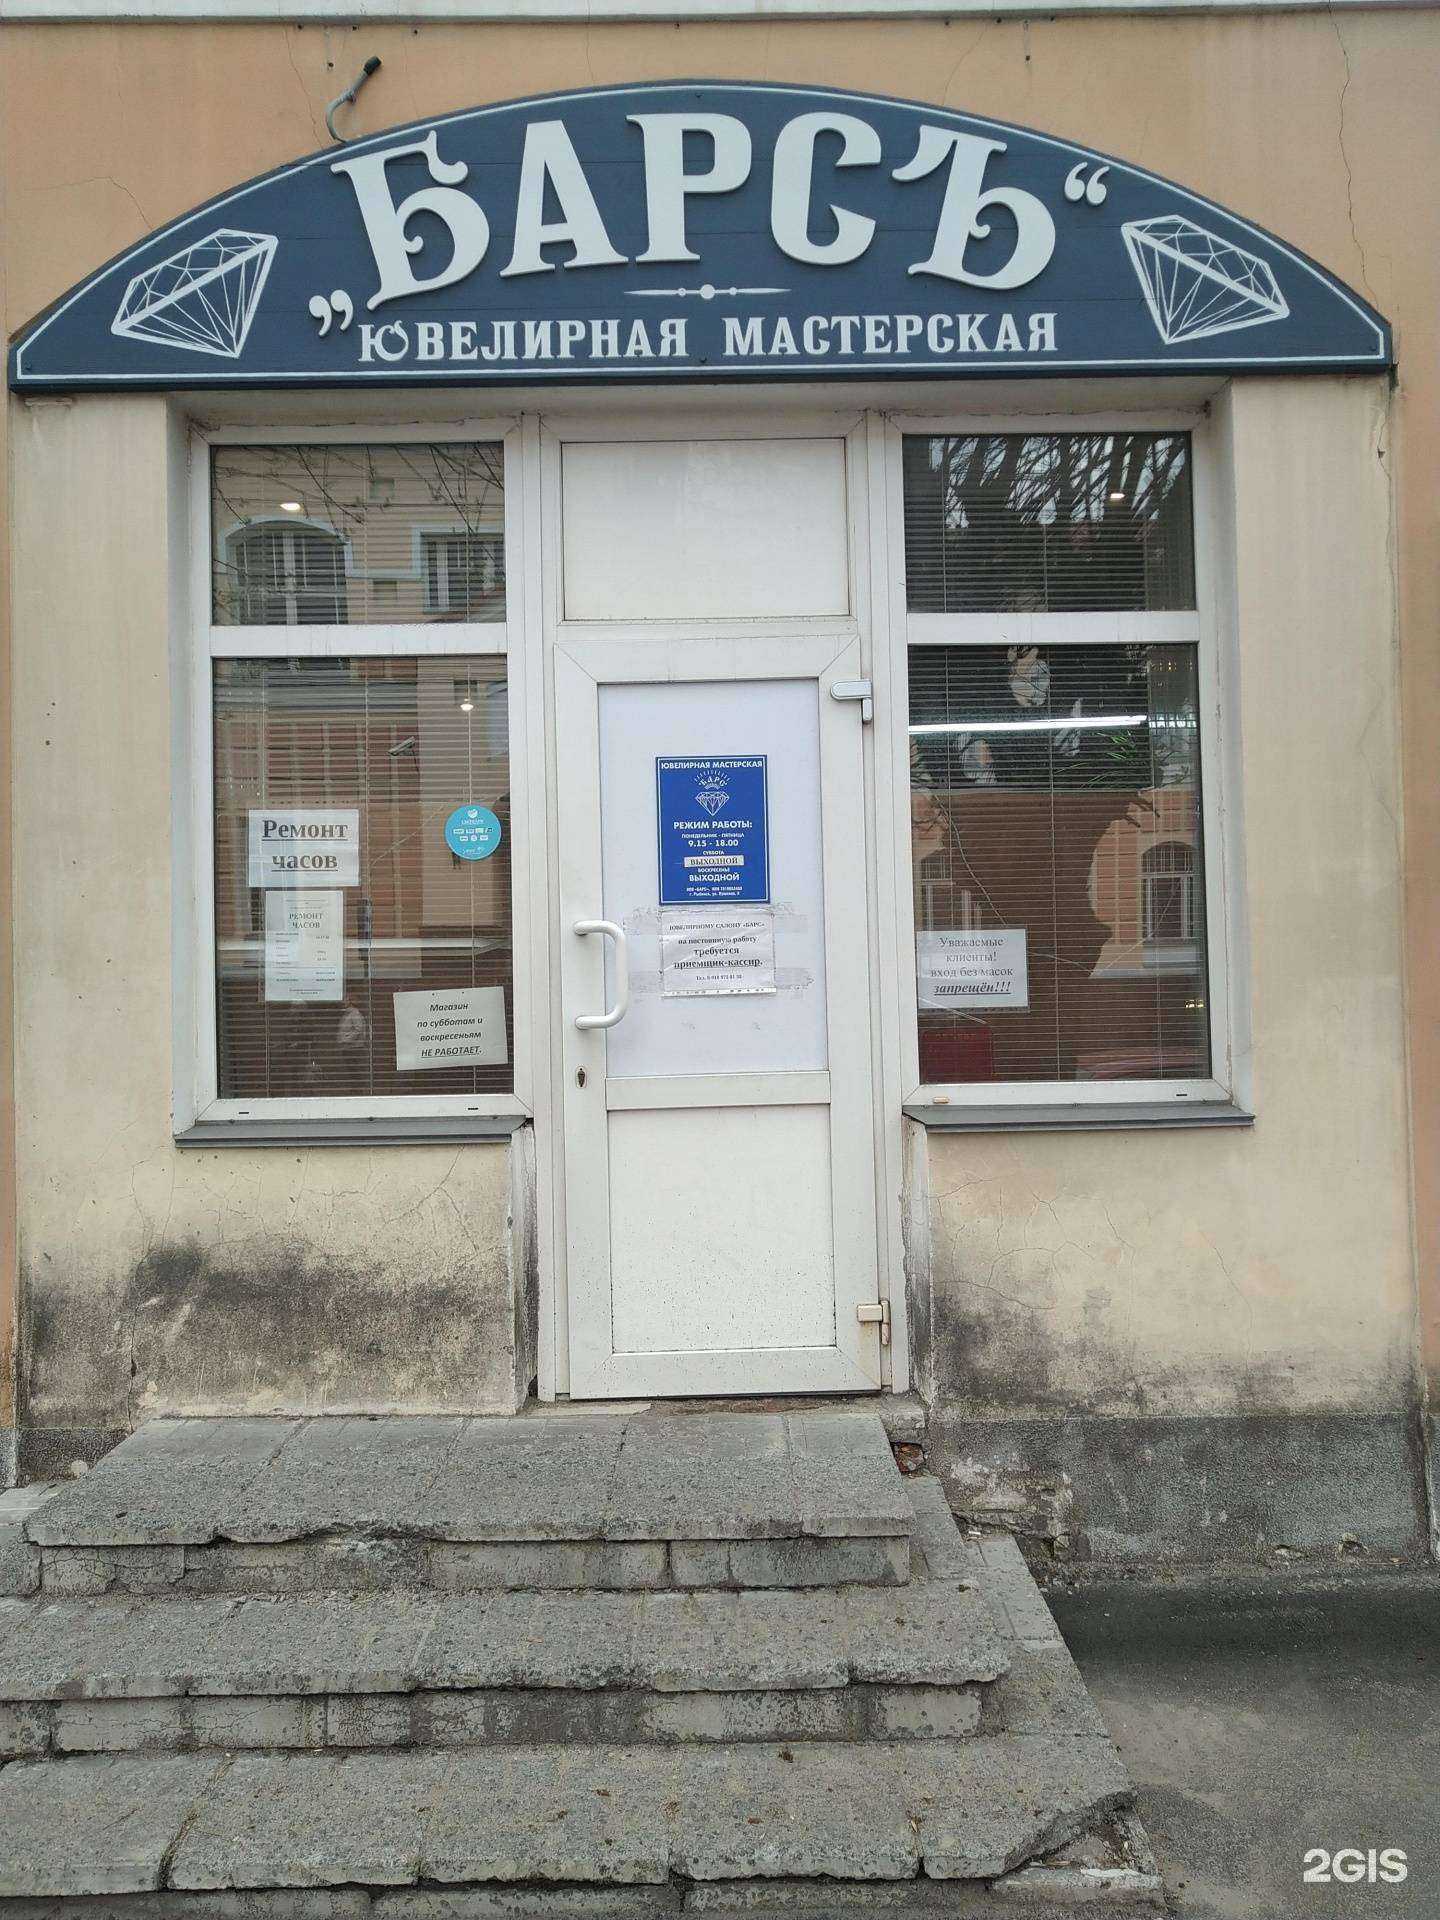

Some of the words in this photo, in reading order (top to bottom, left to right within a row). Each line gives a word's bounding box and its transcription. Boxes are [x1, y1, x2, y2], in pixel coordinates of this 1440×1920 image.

[357, 318, 690, 363] ЮВЕЛИРНАЯ
[721, 312, 1059, 356] МАСТЕРСКАЯ
[661, 761, 711, 770] ЮВЕЛИРНАЯ
[712, 760, 763, 769] МАСТЕРСКАЯ
[261, 819, 349, 839] Ремонт
[673, 821, 710, 830] РЕЖИМ
[712, 820, 753, 829] РАБОТЫ:
[688, 840, 707, 848] 9.15
[715, 839, 739, 847] 18.00
[271, 855, 339, 870] часов
[690, 856, 738, 866] ВЫХОДНОЙ
[689, 872, 740, 882] ВЫХОДНОЙ
[289, 912, 323, 920] РЕМОНТ
[292, 921, 321, 929] ЧАСОВ
[938, 937, 1004, 948] Уважаемые
[693, 946, 740, 957] требуется
[946, 951, 998, 963] клиенты!
[930, 968, 958, 979] вход
[959, 966, 978, 977] без
[979, 967, 1014, 977] масок
[933, 981, 1011, 995] запрещён!!!
[429, 1003, 470, 1012] Магазин
[417, 1020, 428, 1028] по
[429, 1018, 476, 1029] субботам
[420, 1031, 482, 1042] воскресеньям
[421, 1048, 433, 1057] НЕ
[434, 1045, 482, 1056] РАБОТАЕТ.
